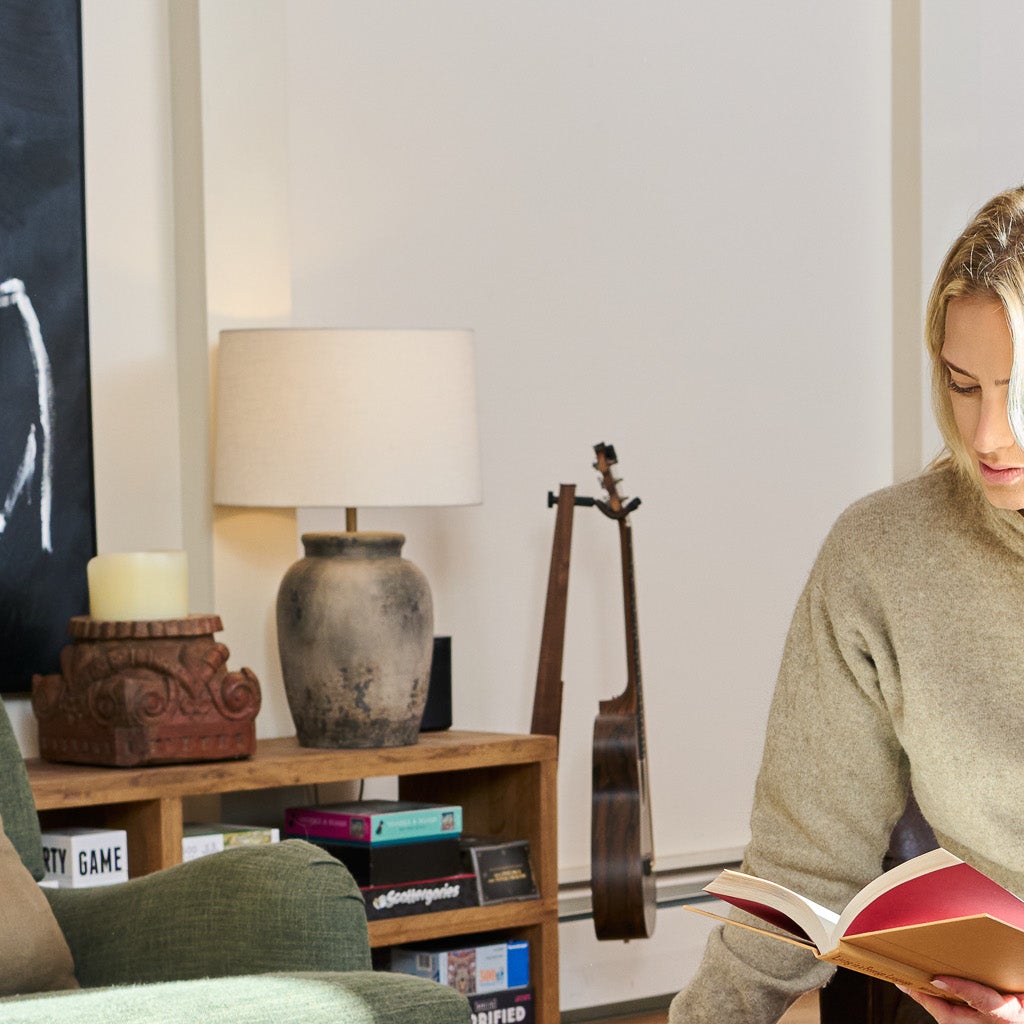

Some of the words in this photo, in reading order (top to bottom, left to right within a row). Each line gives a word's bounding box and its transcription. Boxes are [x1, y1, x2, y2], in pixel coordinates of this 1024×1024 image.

[43, 848, 66, 874] RTY
[79, 846, 122, 876] GAME
[386, 882, 461, 908] Scattergories
